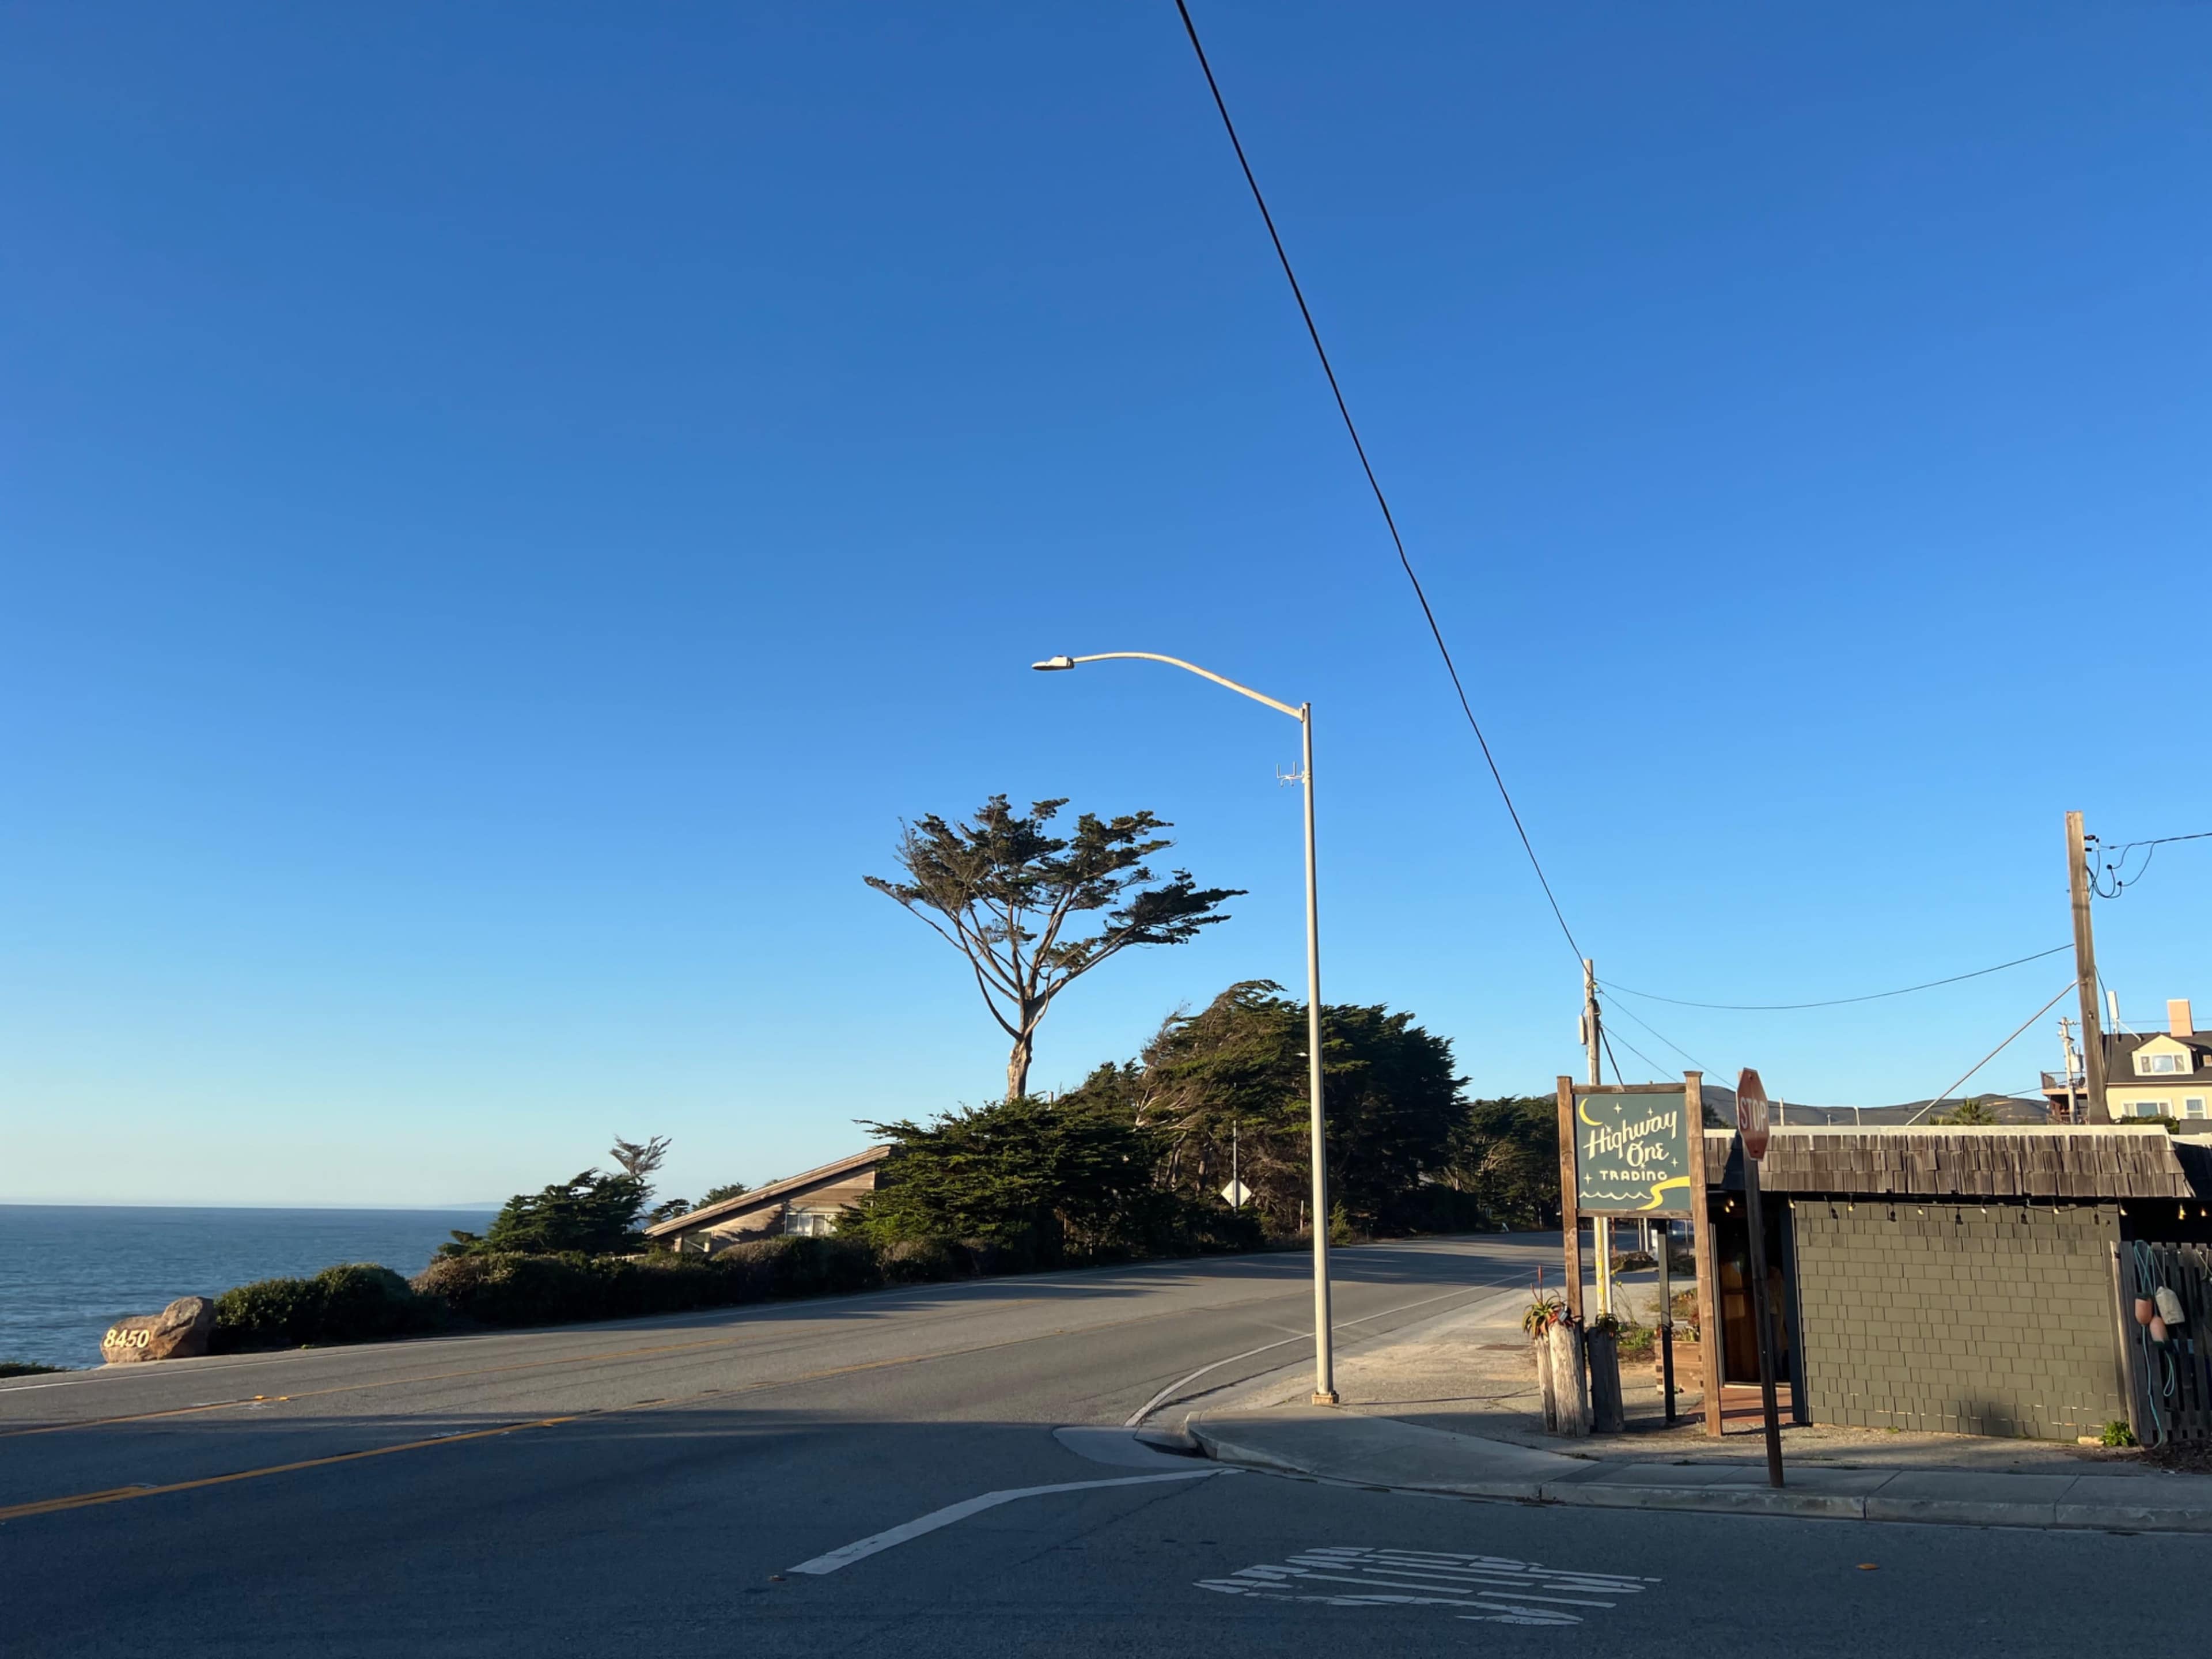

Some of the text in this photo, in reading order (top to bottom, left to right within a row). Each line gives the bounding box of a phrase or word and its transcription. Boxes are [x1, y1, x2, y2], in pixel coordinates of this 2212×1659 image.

[1740, 1096, 1767, 1132] STOP
[1583, 1110, 1677, 1160] Highway
[1626, 1141, 1669, 1167] One
[103, 1329, 150, 1348] 8450
[1191, 1547, 1664, 1626] STOP
